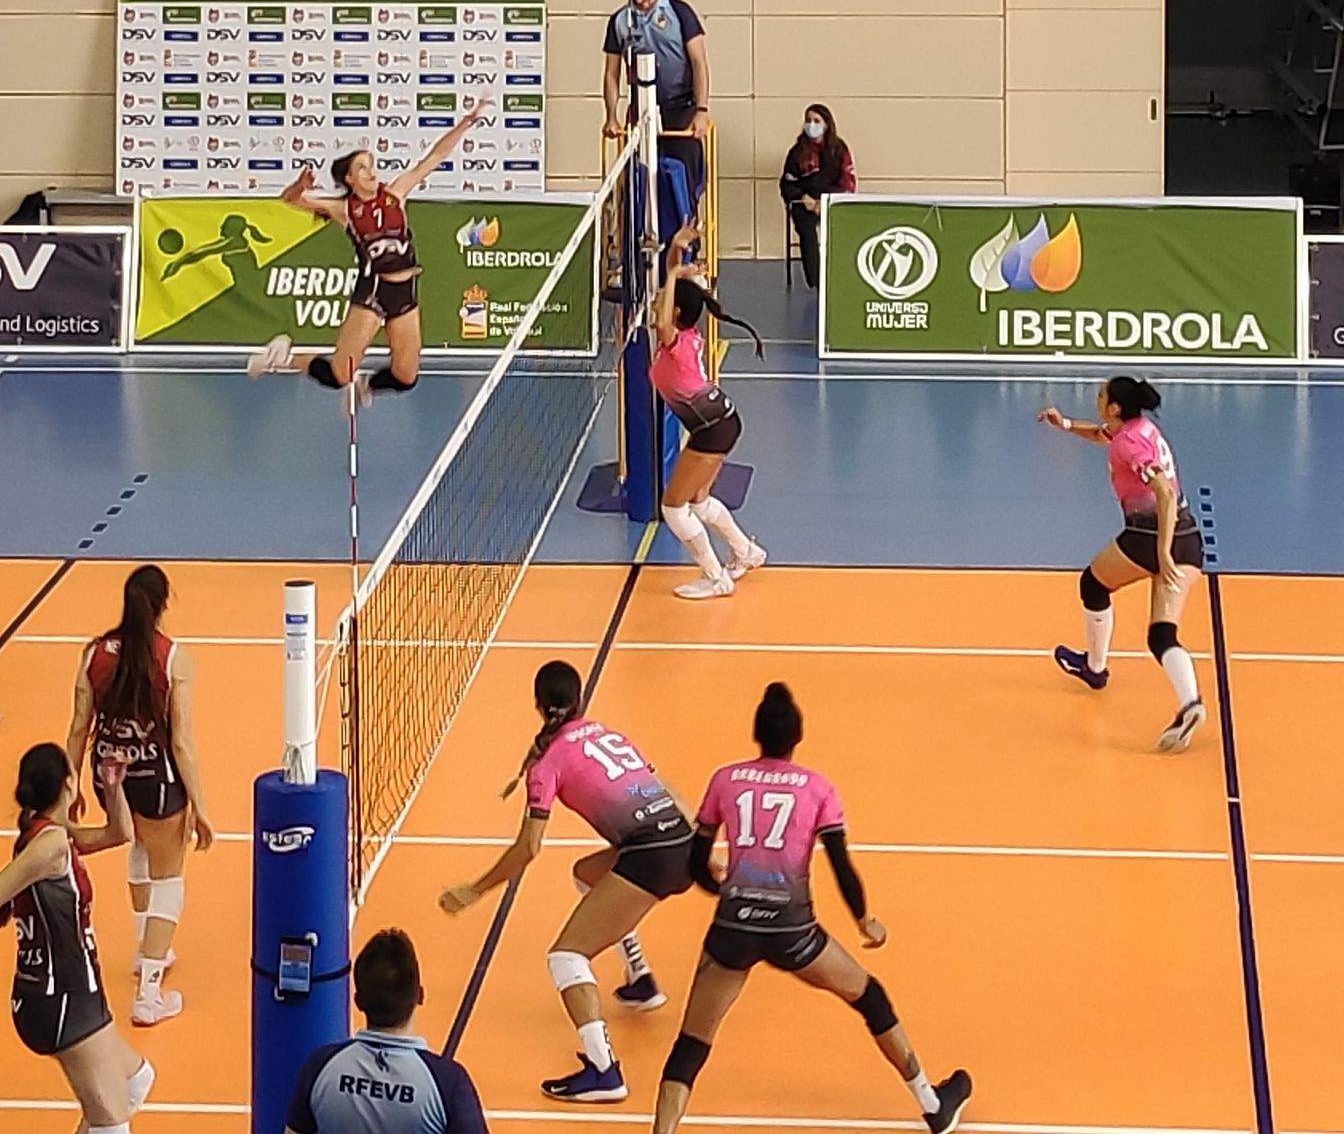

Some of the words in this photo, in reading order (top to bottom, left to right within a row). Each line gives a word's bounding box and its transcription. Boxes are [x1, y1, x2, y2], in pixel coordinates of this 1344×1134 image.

[866, 302, 929, 314] UNIVERSO
[866, 314, 928, 328] MUJER
[26, 314, 99, 337] Logistics
[998, 310, 1268, 350] IBERDROLA
[583, 732, 646, 781] 15
[736, 789, 796, 849] 17
[339, 1074, 414, 1103] RFEVB
